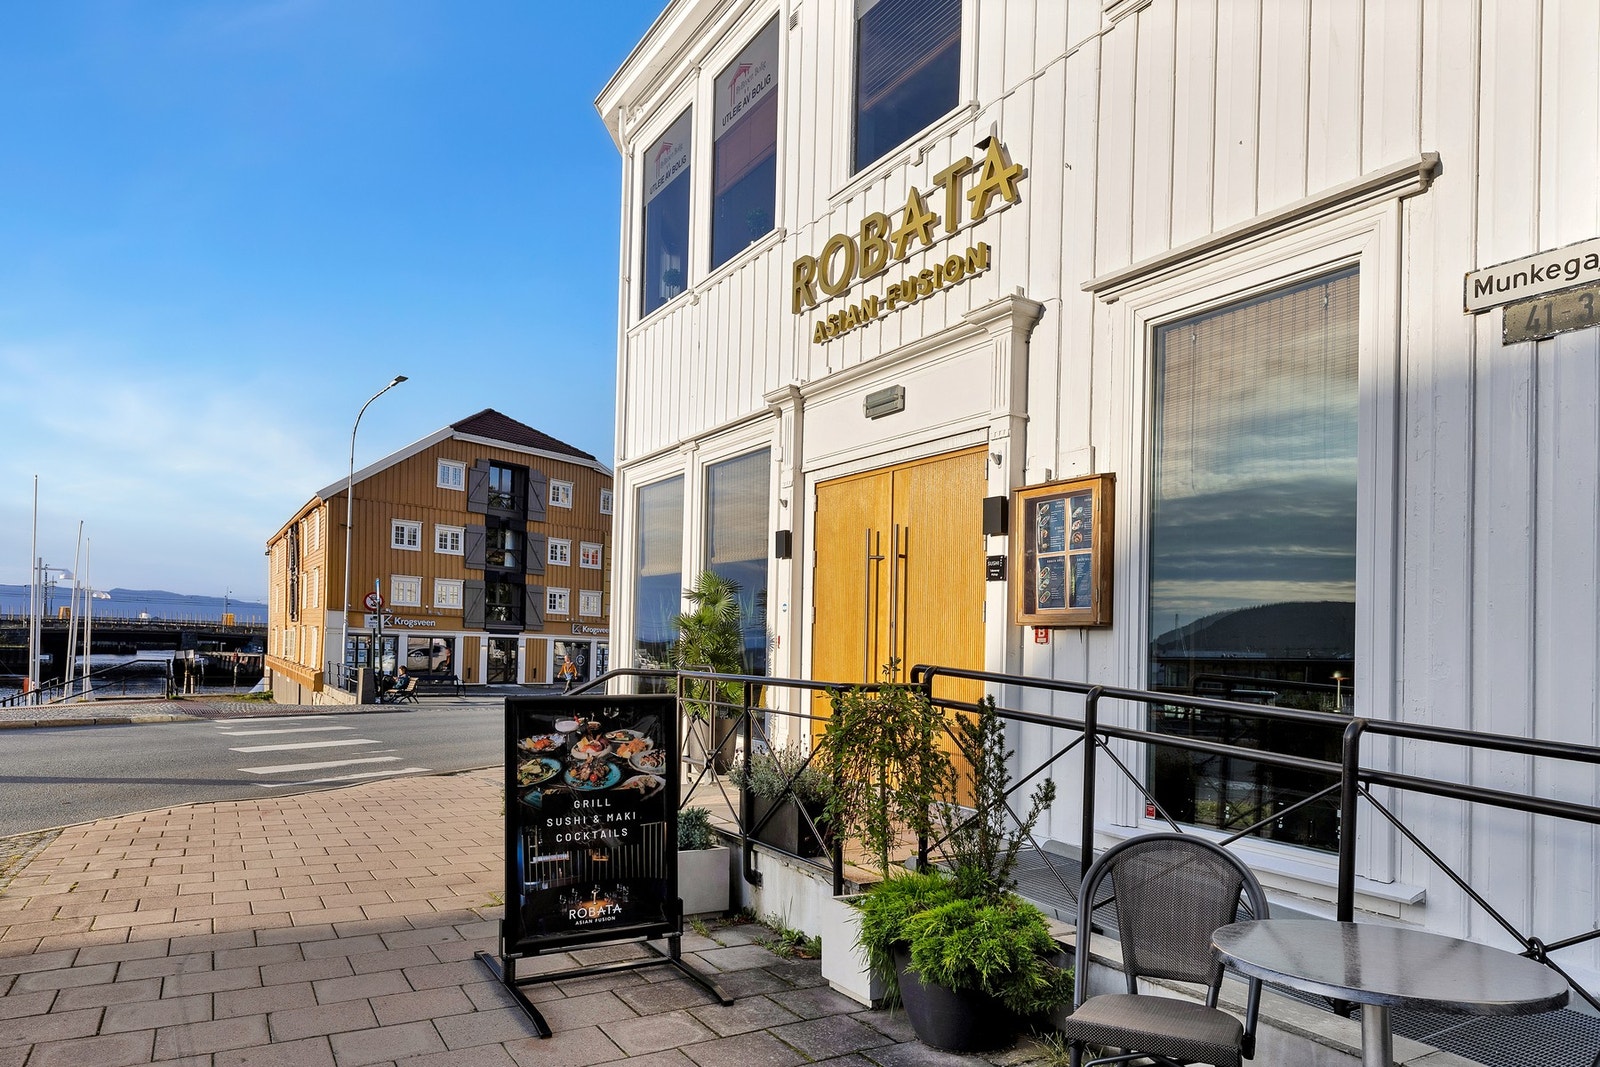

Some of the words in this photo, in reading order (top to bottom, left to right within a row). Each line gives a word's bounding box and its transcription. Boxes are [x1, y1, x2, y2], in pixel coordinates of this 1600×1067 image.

[722, 101, 741, 126] UTLEIE
[742, 93, 751, 107] AV
[752, 74, 771, 99] BOLIG
[672, 155, 687, 174] BOLIG
[792, 136, 1022, 315] ROBATA
[1474, 252, 1600, 298] Munkega
[813, 295, 878, 343] ASIAN
[886, 241, 987, 311] FUSION
[394, 617, 436, 628] Krogsveen
[573, 798, 611, 809] GRILL
[546, 816, 586, 827] SUSHI
[593, 815, 600, 824] &
[606, 811, 636, 822] MAKI
[555, 828, 628, 843] COCKTAILS
[569, 904, 622, 920] ROBATA
